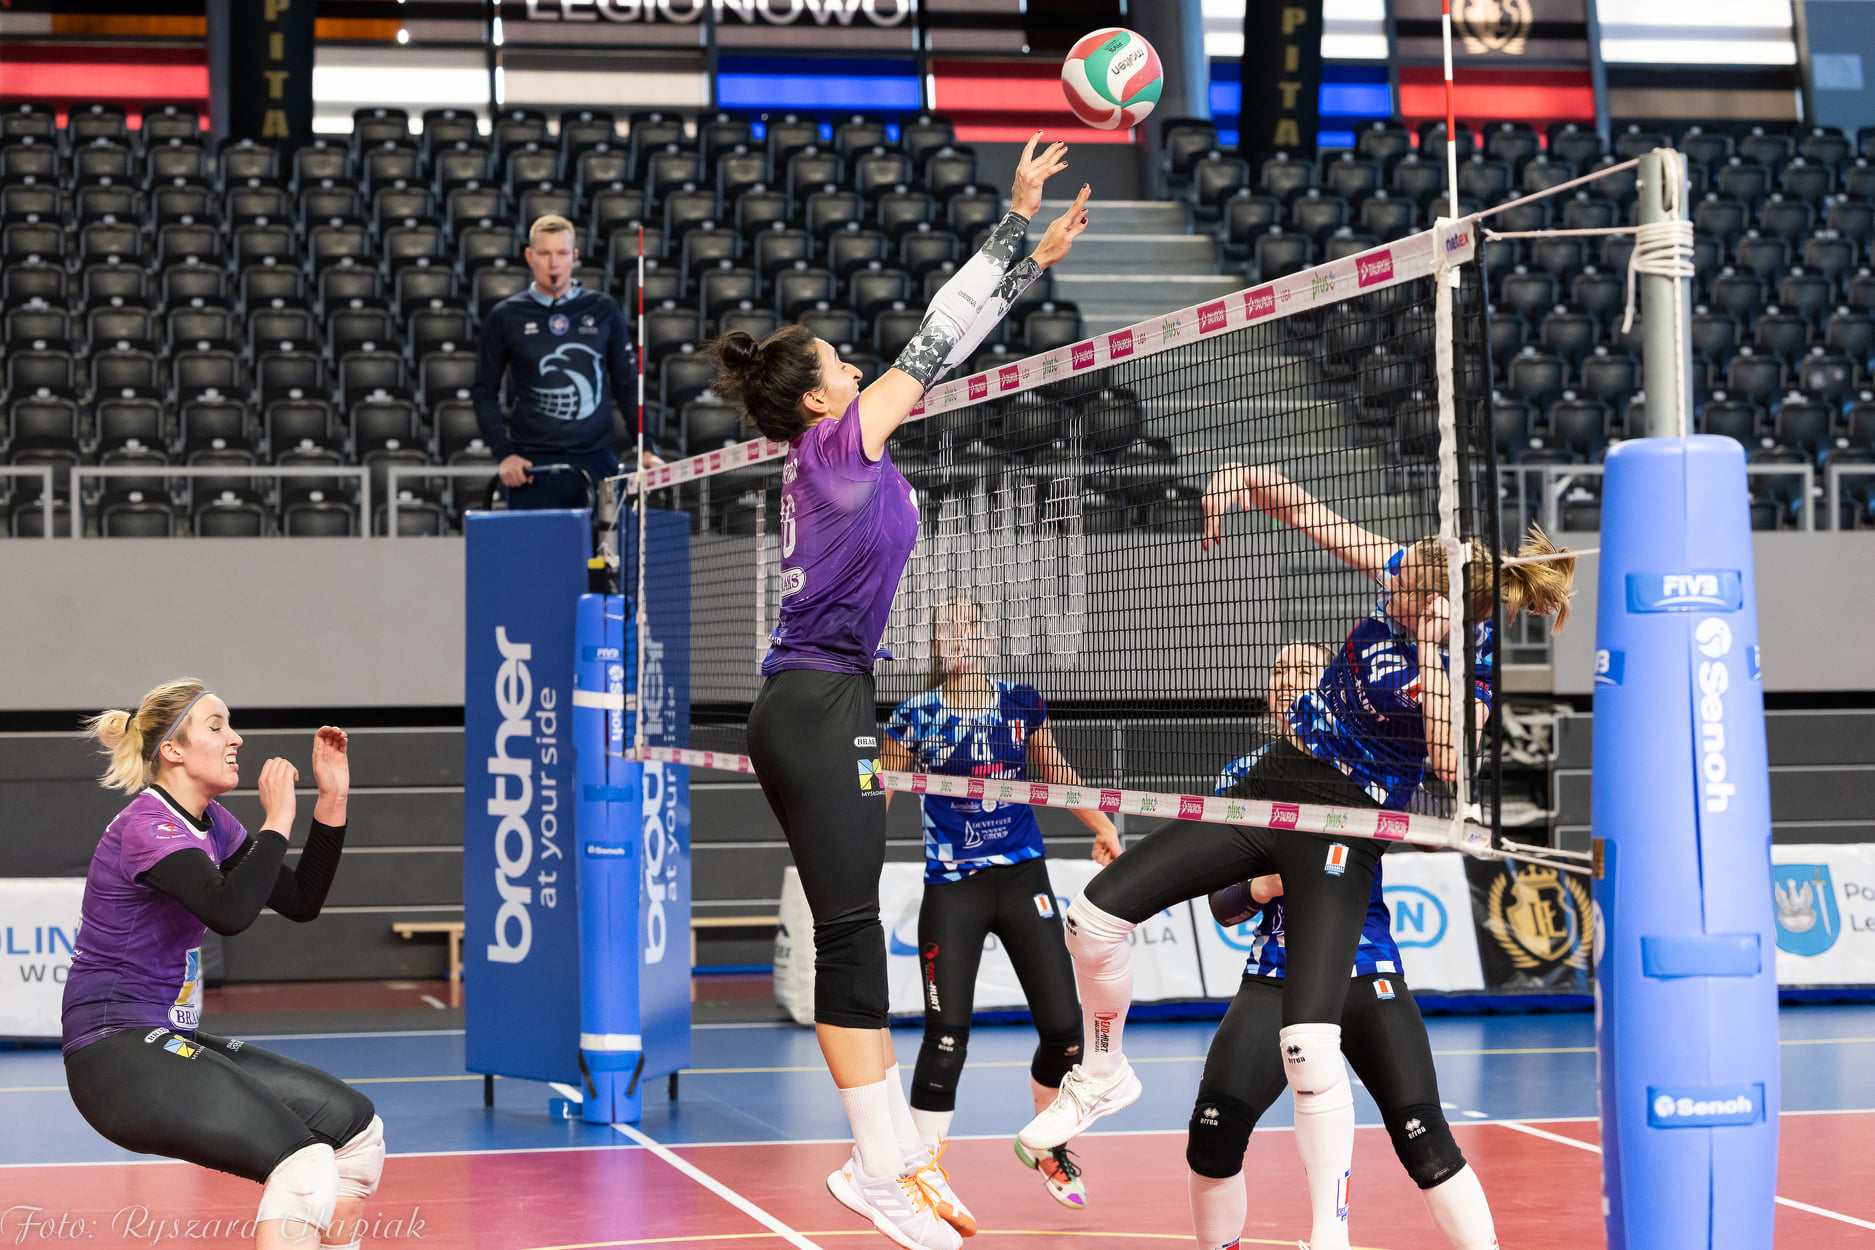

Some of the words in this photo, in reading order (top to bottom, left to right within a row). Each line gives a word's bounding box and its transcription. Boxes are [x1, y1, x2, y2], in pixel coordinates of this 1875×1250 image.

[1273, 7, 1307, 146] PITA
[1445, 232, 1469, 253] netex
[1312, 271, 1330, 301] plus
[1162, 318, 1176, 344] plus
[1662, 575, 1719, 597] FIVB
[535, 687, 558, 765] side
[1698, 660, 1736, 813] Senoh
[487, 625, 533, 964] brother
[1140, 793, 1154, 815] plus
[540, 771, 563, 861] your
[666, 767, 681, 855] your
[1224, 801, 1241, 822] plus
[1279, 810, 1297, 823] TAURON
[1323, 808, 1342, 832] plus
[537, 870, 557, 909] at
[666, 865, 678, 902] at
[0, 926, 79, 955] LIN
[1676, 1095, 1752, 1117] Senoh
[1200, 1117, 1218, 1127] errea
[1407, 1125, 1426, 1140] errea
